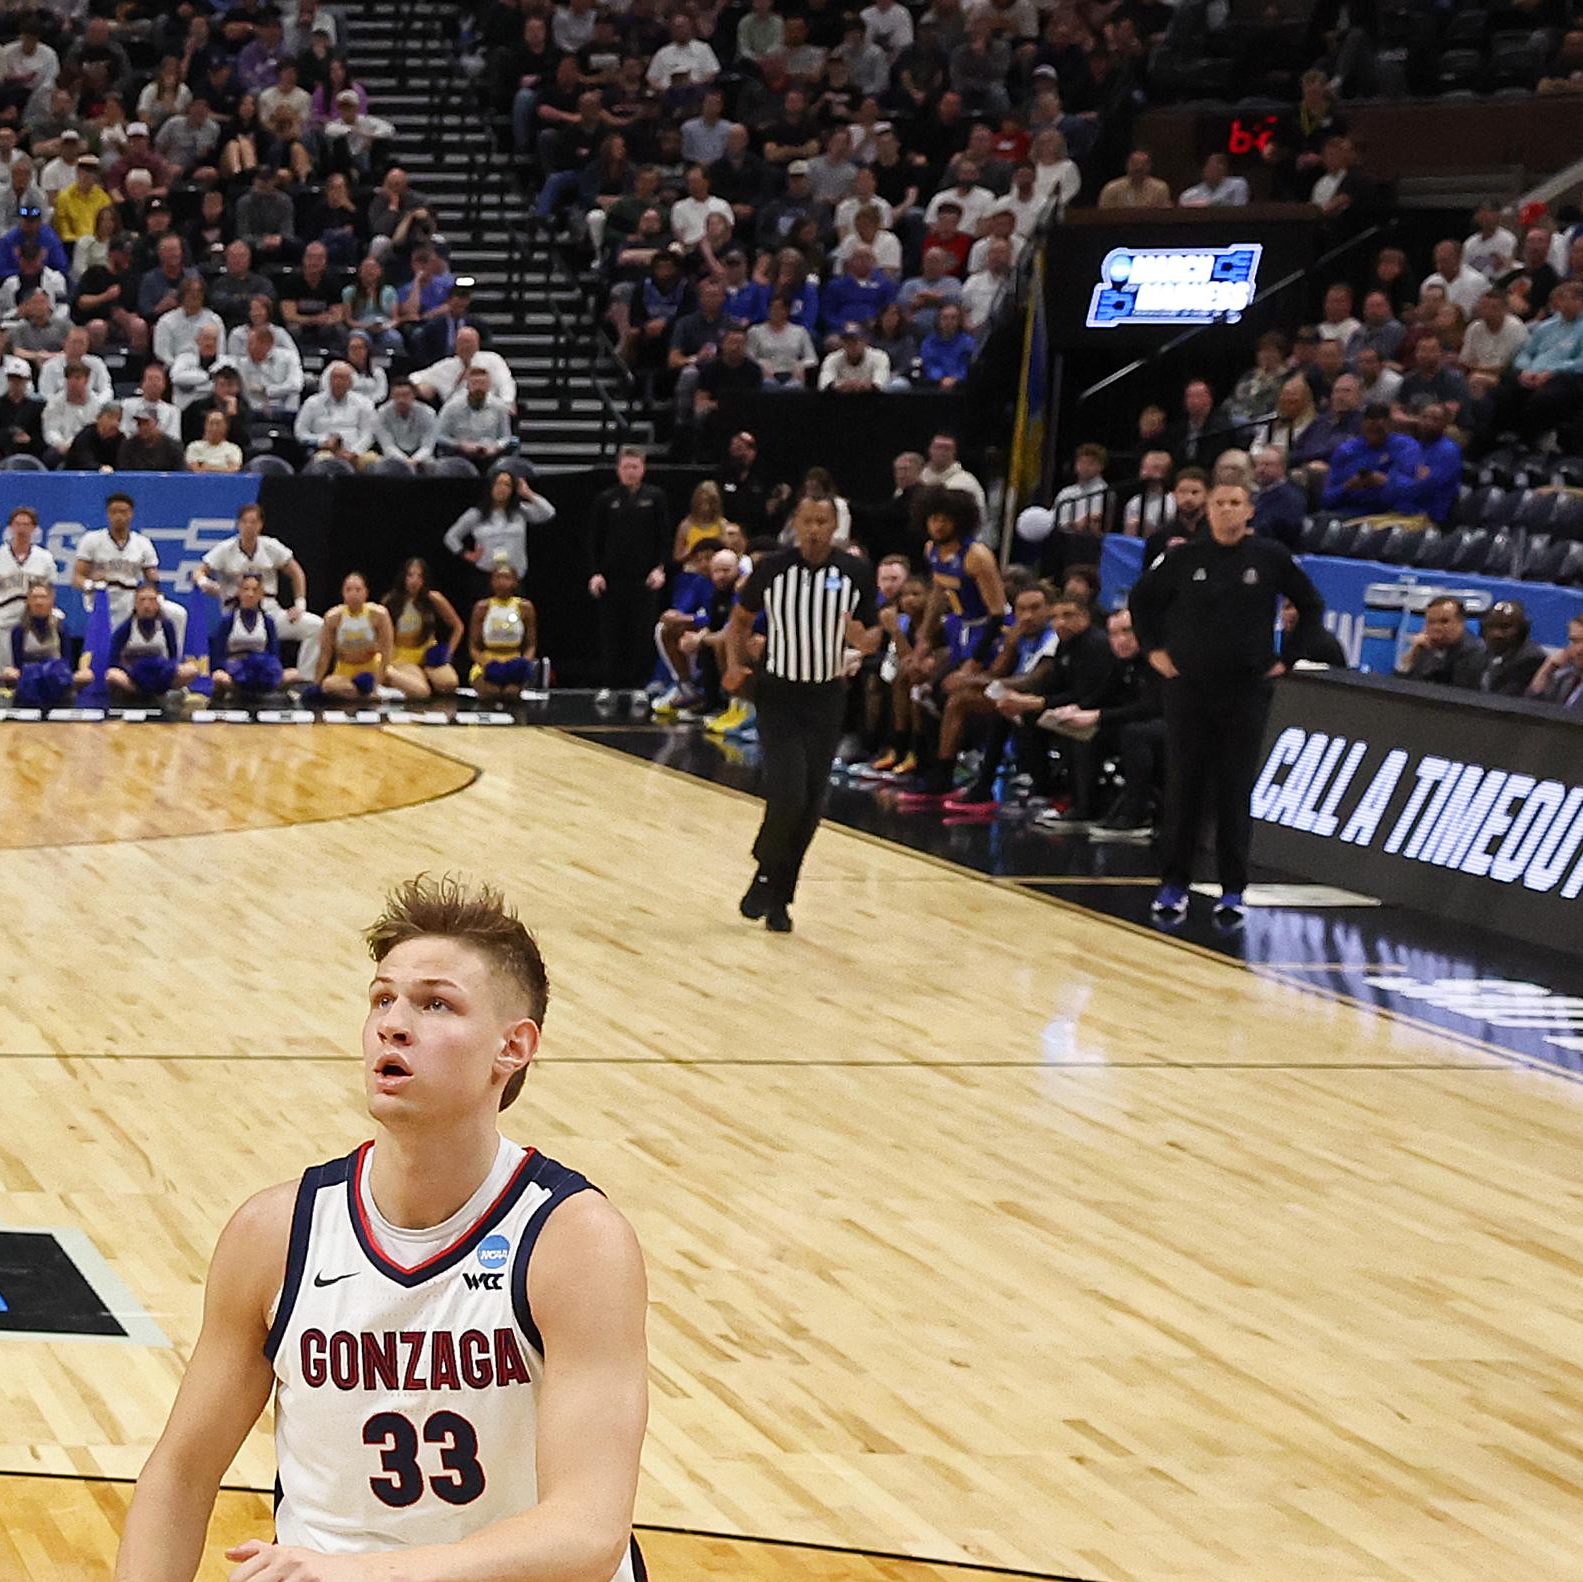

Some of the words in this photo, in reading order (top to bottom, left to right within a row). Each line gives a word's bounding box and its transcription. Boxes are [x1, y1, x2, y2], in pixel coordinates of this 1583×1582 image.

[1249, 726, 1368, 838] CALL
[1339, 749, 1409, 847] A
[300, 1327, 532, 1391] GONZAGA
[362, 1409, 486, 1508] 33
